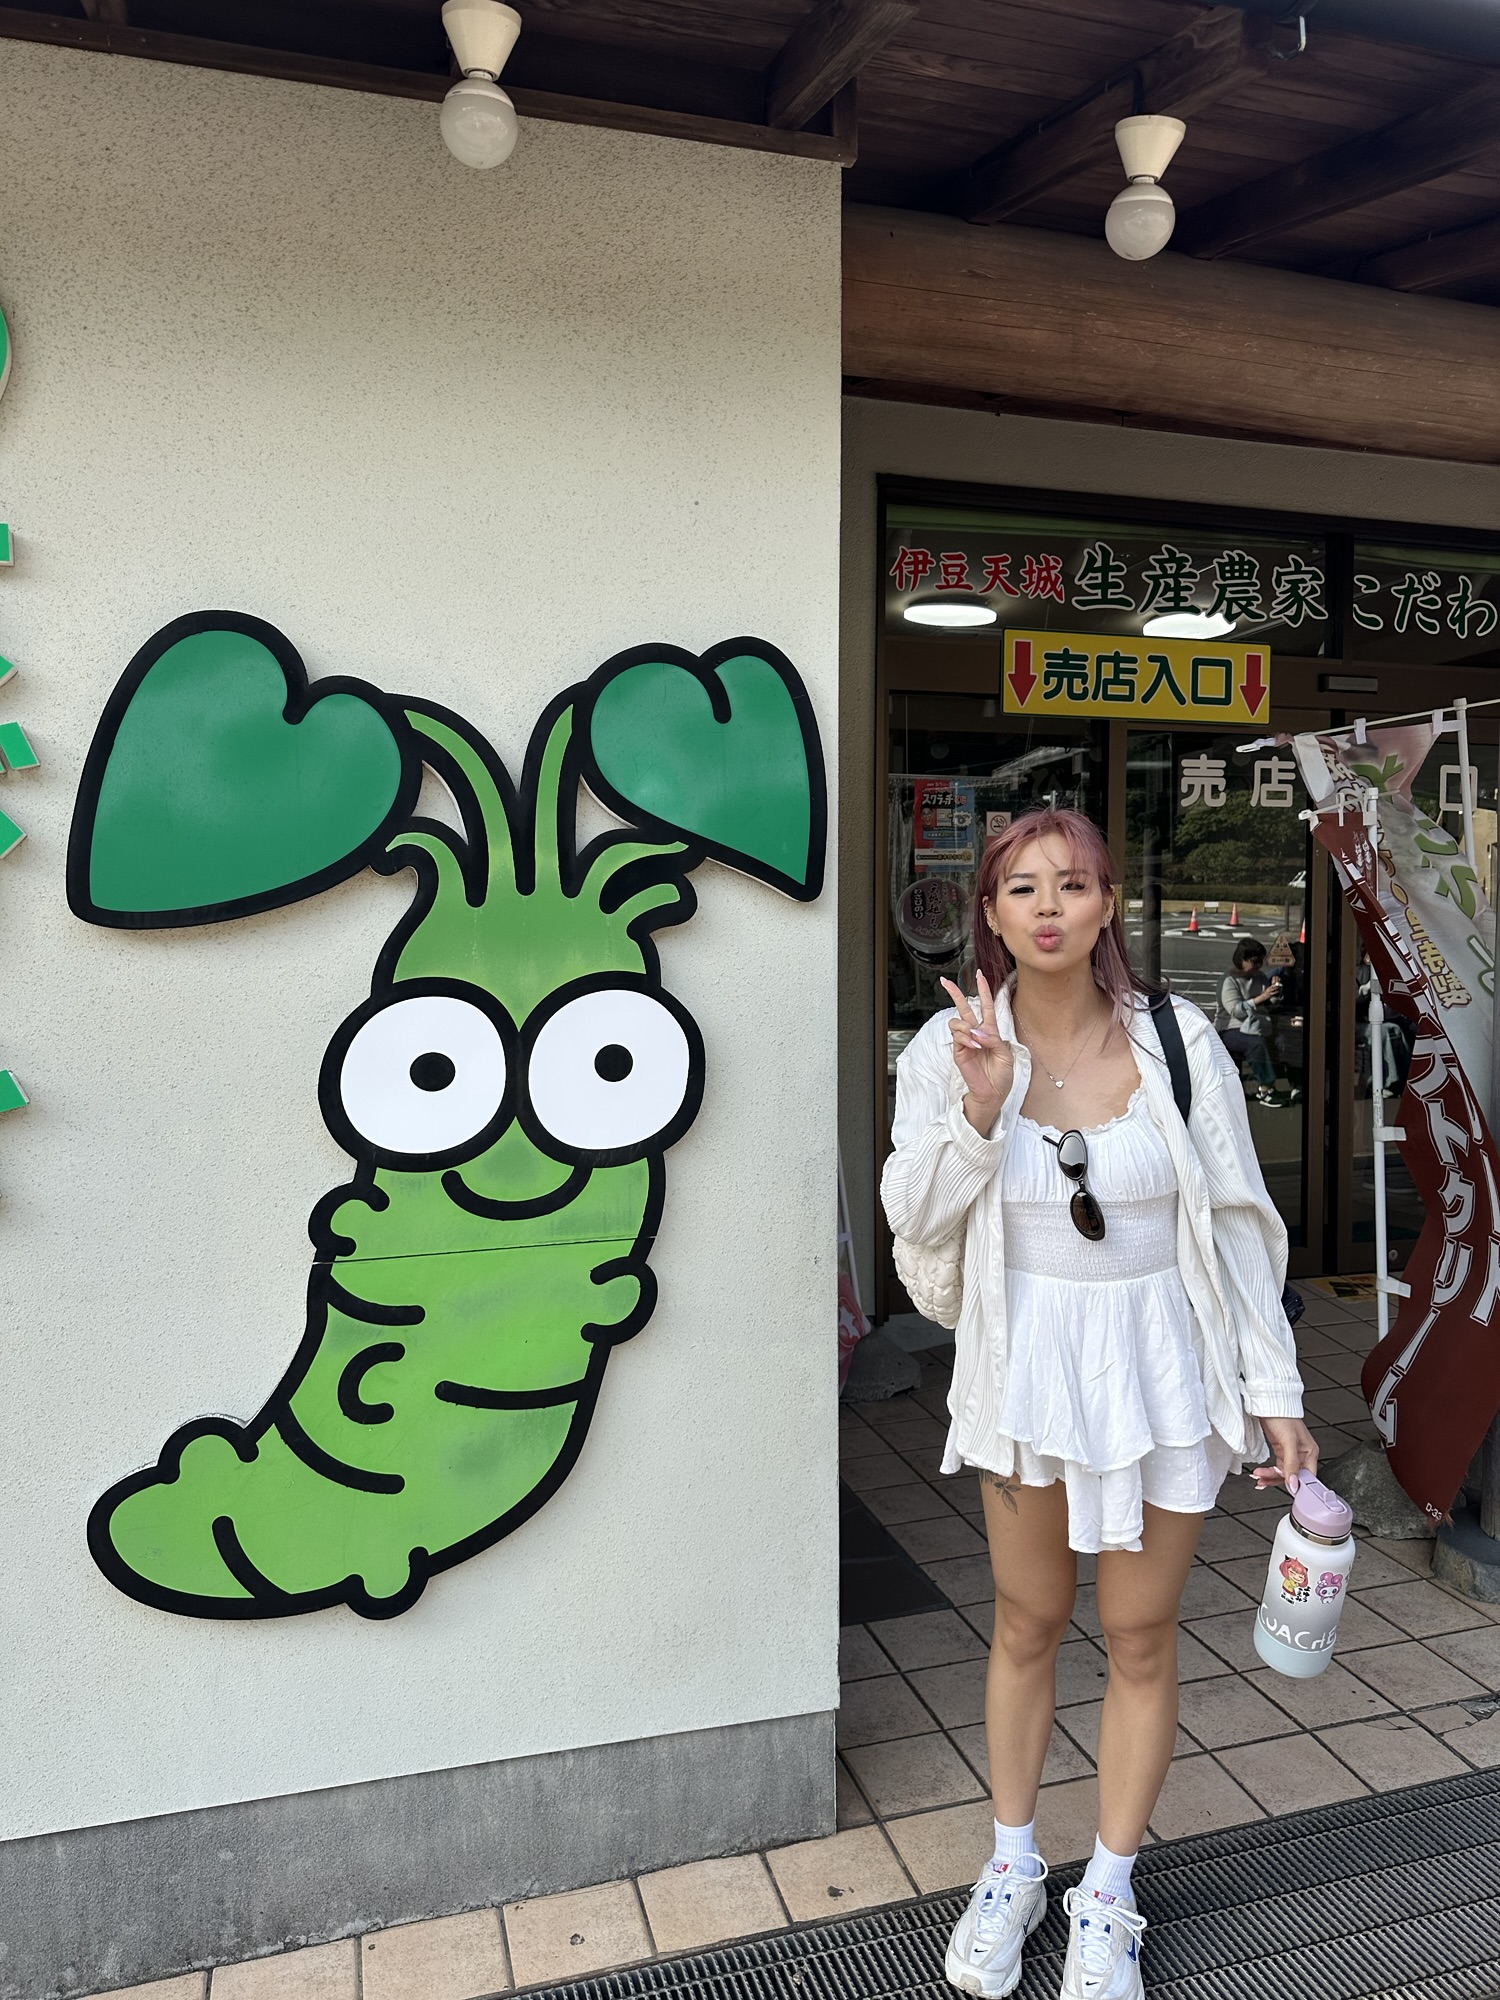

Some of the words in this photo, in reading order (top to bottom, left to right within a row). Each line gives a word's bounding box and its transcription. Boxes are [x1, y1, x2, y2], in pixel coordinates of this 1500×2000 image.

[889, 545, 1065, 604] 伊豆天城
[1042, 647, 1233, 707] 売店入口
[1097, 1892, 1114, 1904] NIKE
